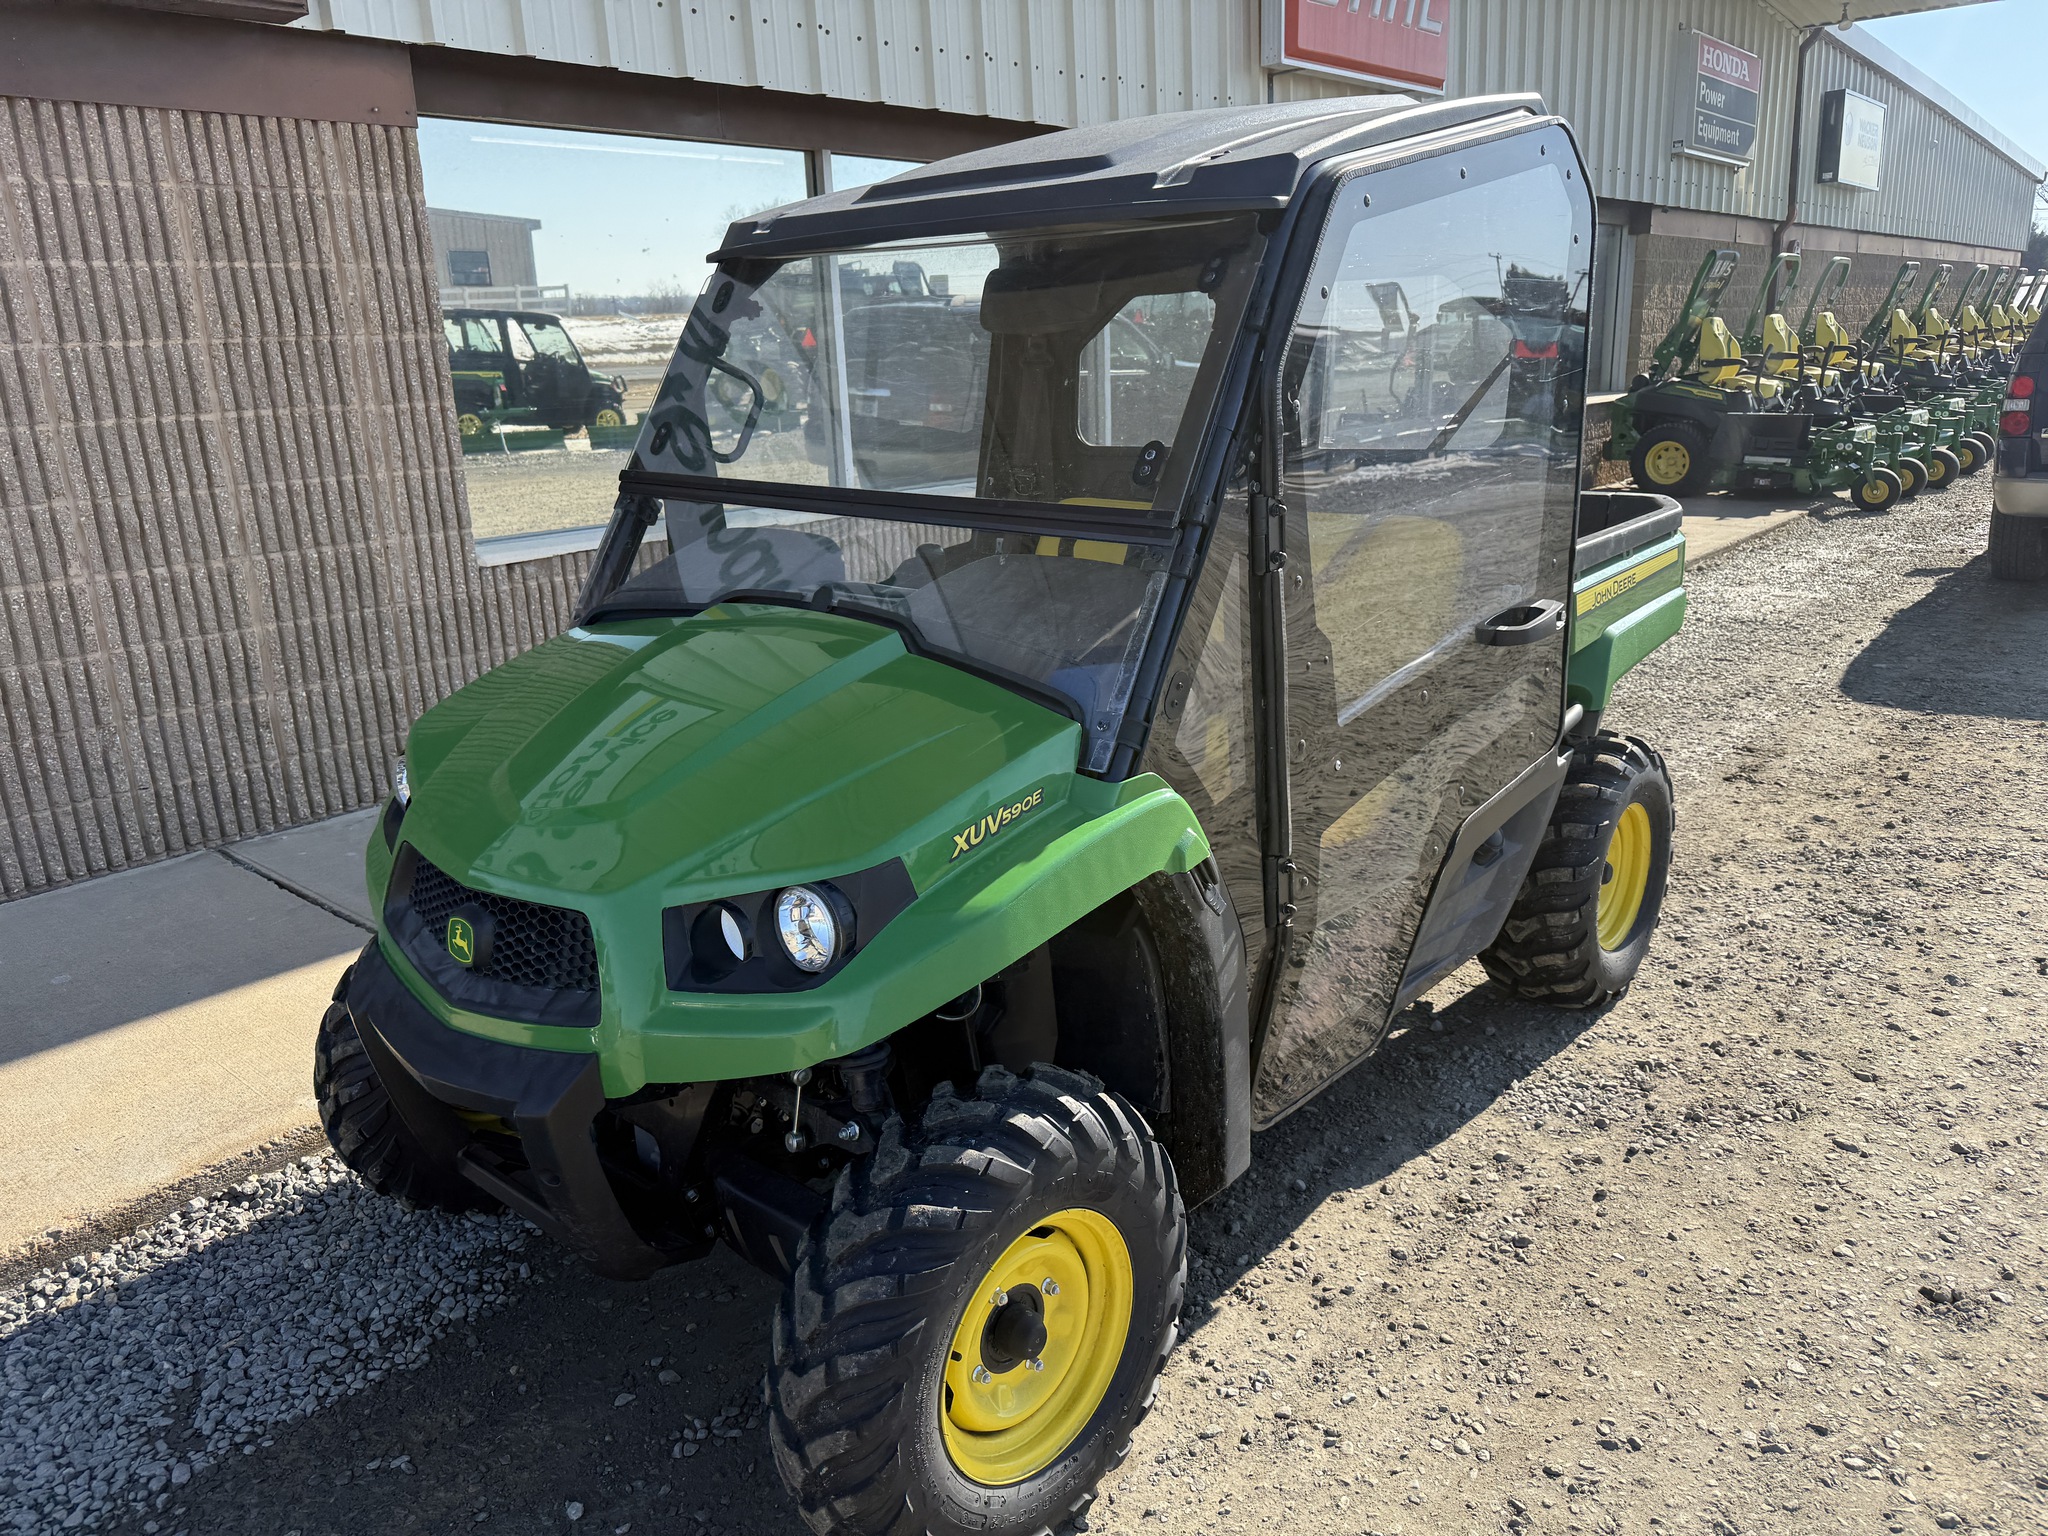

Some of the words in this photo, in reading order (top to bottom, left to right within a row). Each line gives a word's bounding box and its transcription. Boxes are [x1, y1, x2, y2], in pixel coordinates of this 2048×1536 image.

[1702, 44, 1750, 82] HONDA
[1700, 81, 1725, 109] Power
[1697, 115, 1740, 146] Equipment
[1592, 585, 1612, 608] JOHN
[1612, 573, 1637, 596] DEERE
[949, 787, 1044, 863] XUV590E
